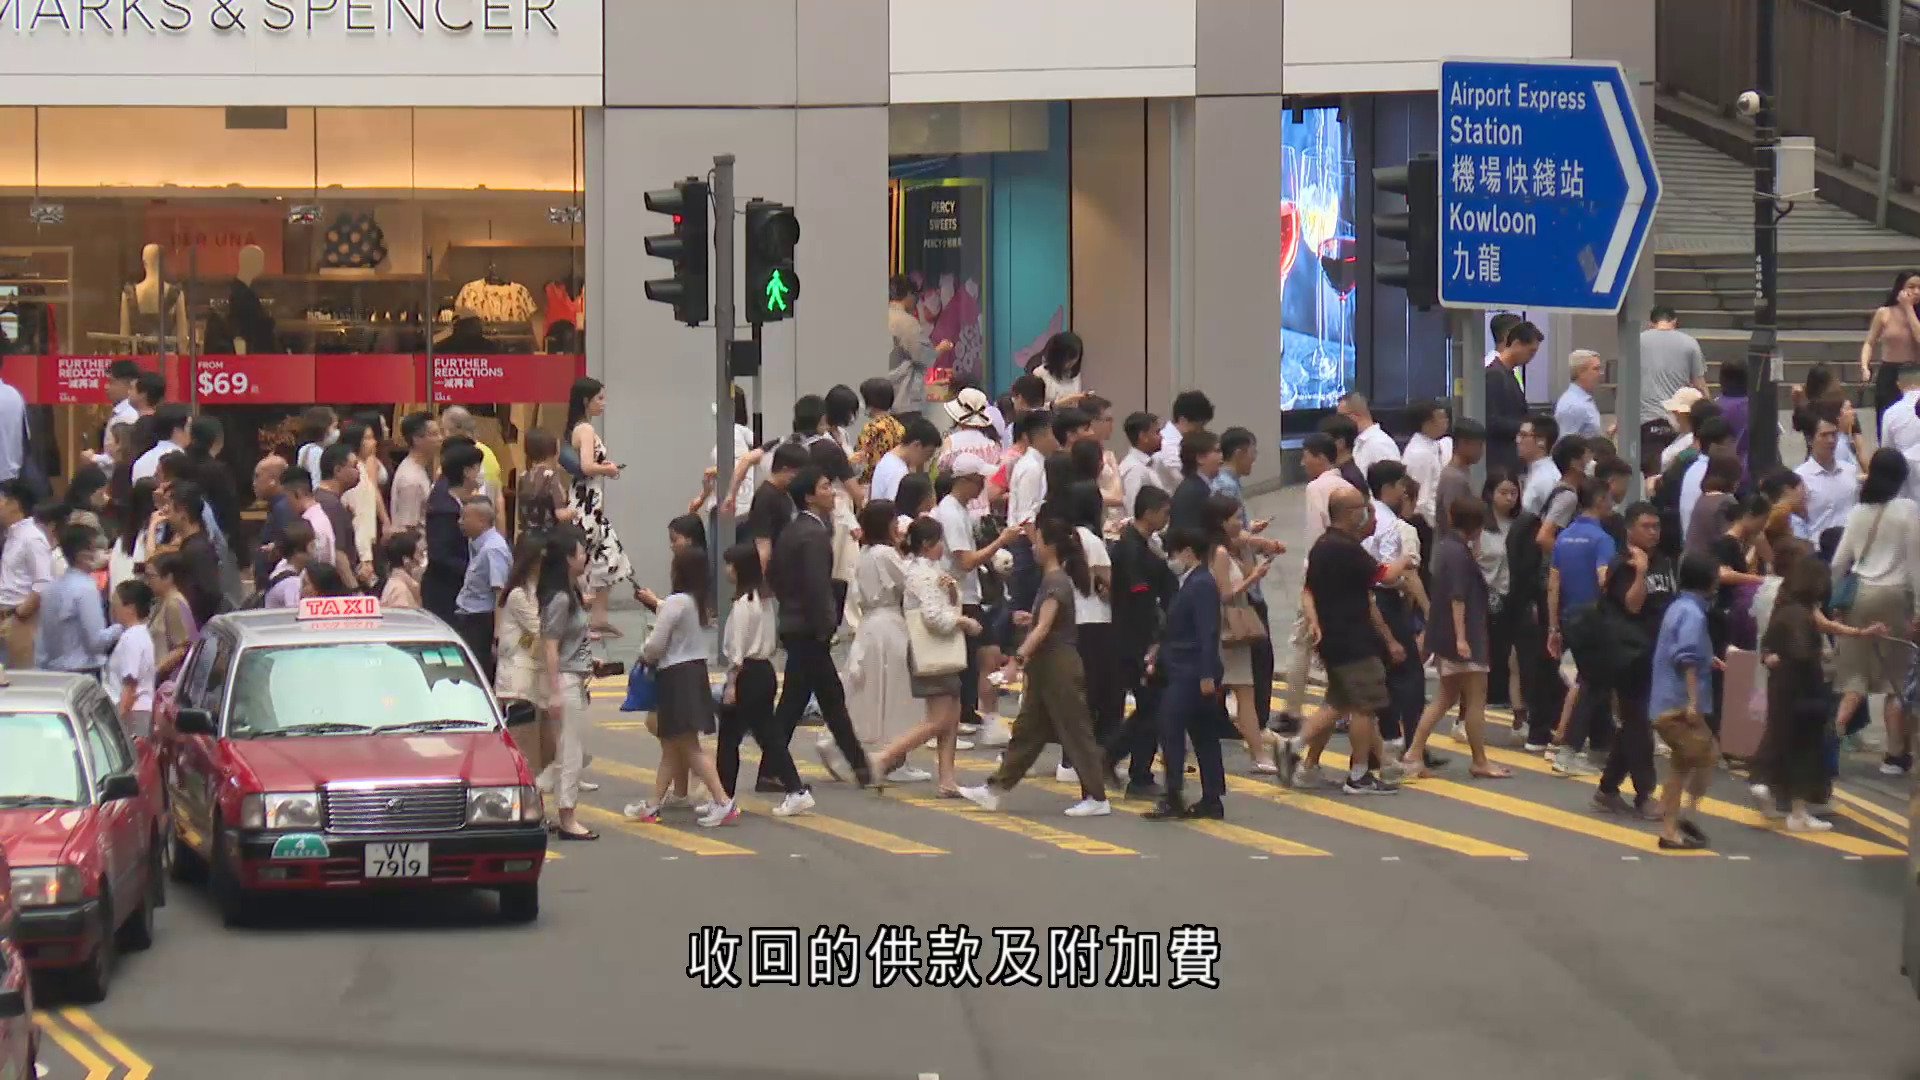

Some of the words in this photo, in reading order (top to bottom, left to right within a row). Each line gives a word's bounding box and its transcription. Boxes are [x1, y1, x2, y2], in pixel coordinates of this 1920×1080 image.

[0, 0, 192, 30] ARKS
[210, 0, 247, 30] &
[263, 0, 557, 30] SPENCER
[1451, 80, 1511, 110] Airport
[1518, 82, 1586, 113] Express
[1451, 115, 1522, 145] Station
[1452, 154, 1584, 198] 機場快綫站
[931, 200, 955, 213] PERCY
[929, 218, 957, 231] SWEETS
[1450, 202, 1536, 235] Kowloon
[1452, 241, 1501, 282] 九龍
[197, 361, 223, 369] FROM
[434, 358, 488, 367] FURTHER
[434, 367, 504, 377] REDUCTIONS
[198, 370, 248, 396] $69
[306, 599, 374, 615] TAXI
[295, 839, 306, 850] 4
[372, 860, 421, 876] 7919
